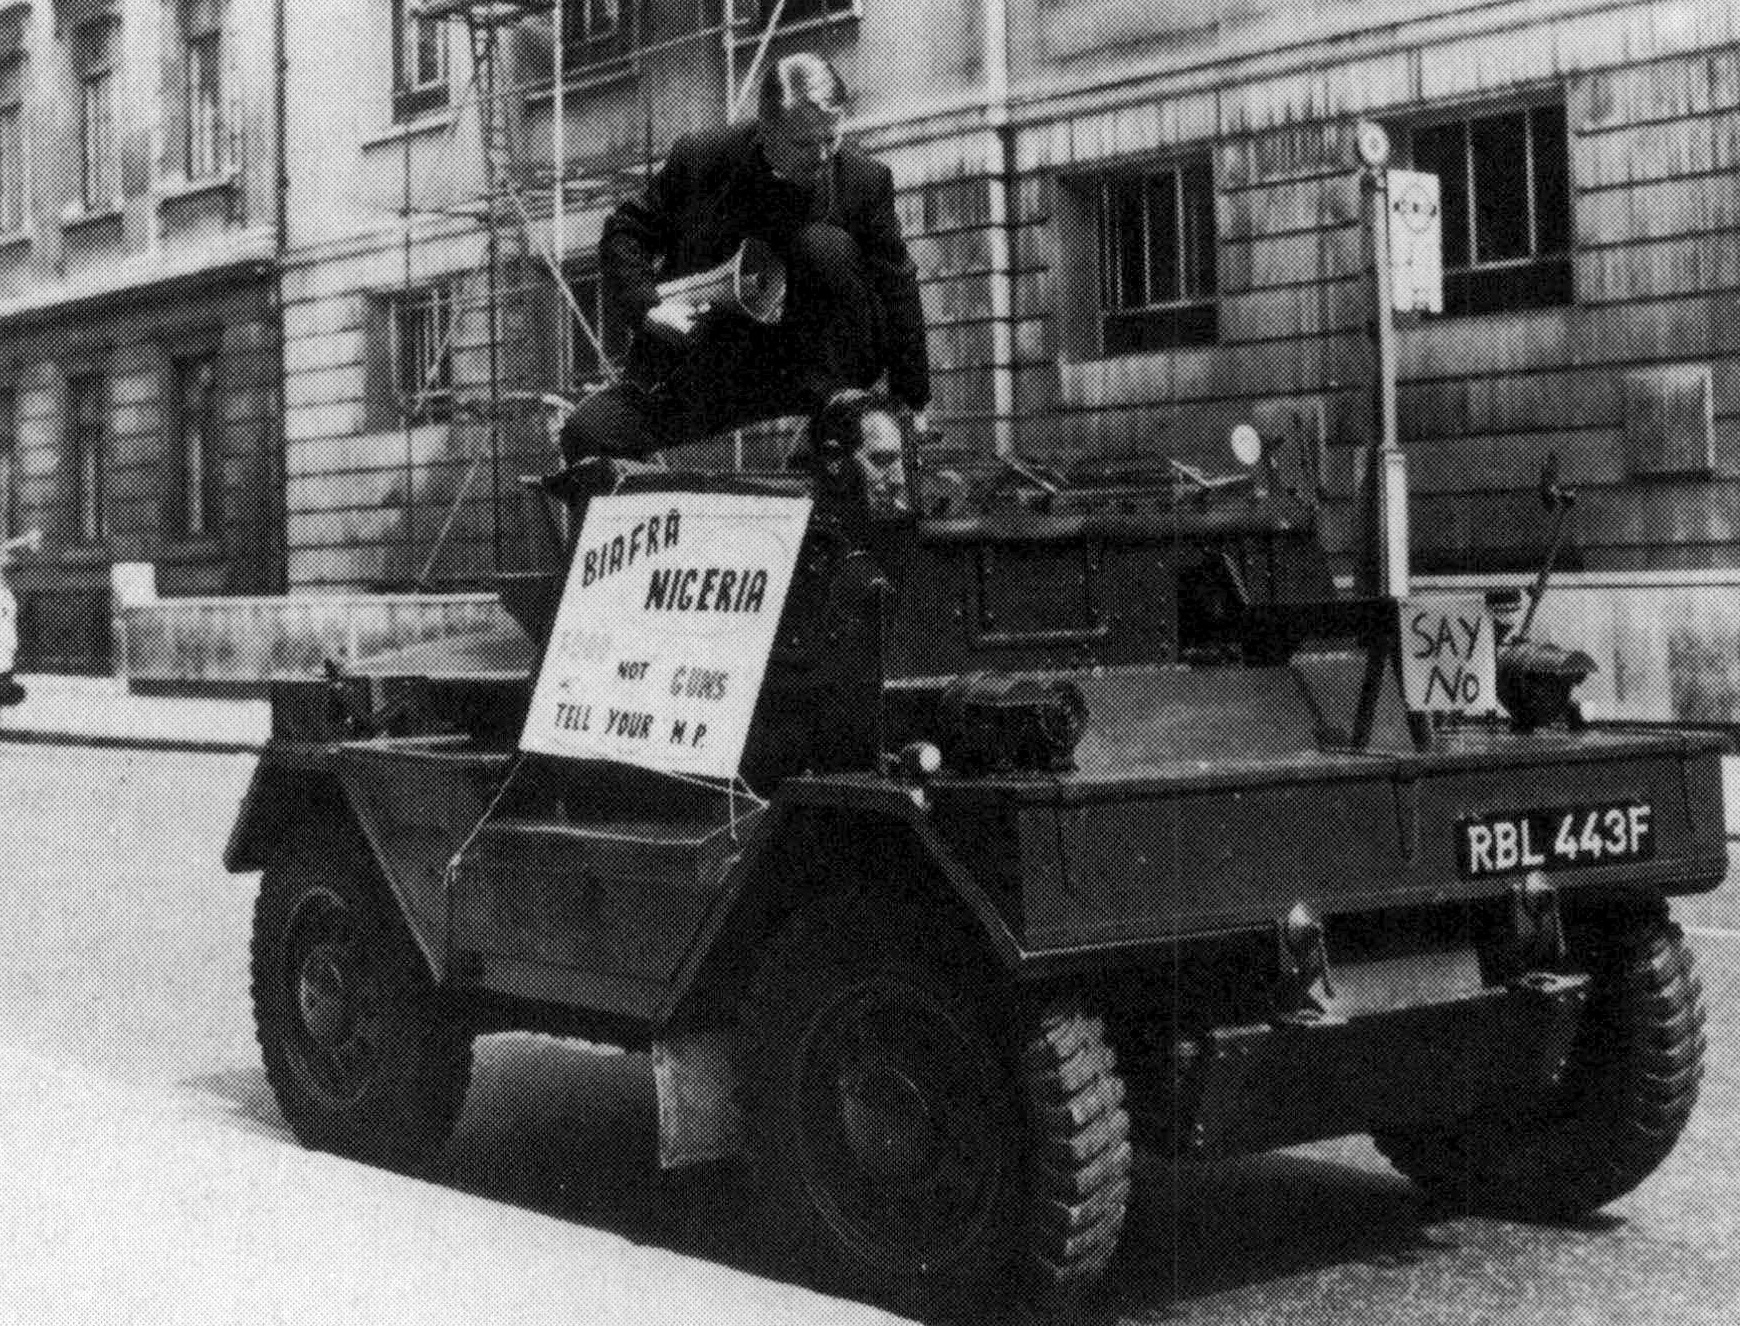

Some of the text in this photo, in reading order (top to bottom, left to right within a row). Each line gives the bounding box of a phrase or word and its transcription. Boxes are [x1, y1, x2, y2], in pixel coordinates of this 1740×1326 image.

[582, 508, 681, 588] BIAFRA
[644, 567, 768, 613] NIGERIA
[1411, 611, 1481, 660] SAY
[617, 661, 729, 701] NOT GUNS
[555, 702, 592, 733] TELL
[605, 708, 654, 739] YOUR
[1468, 805, 1651, 873] RBL 443F
